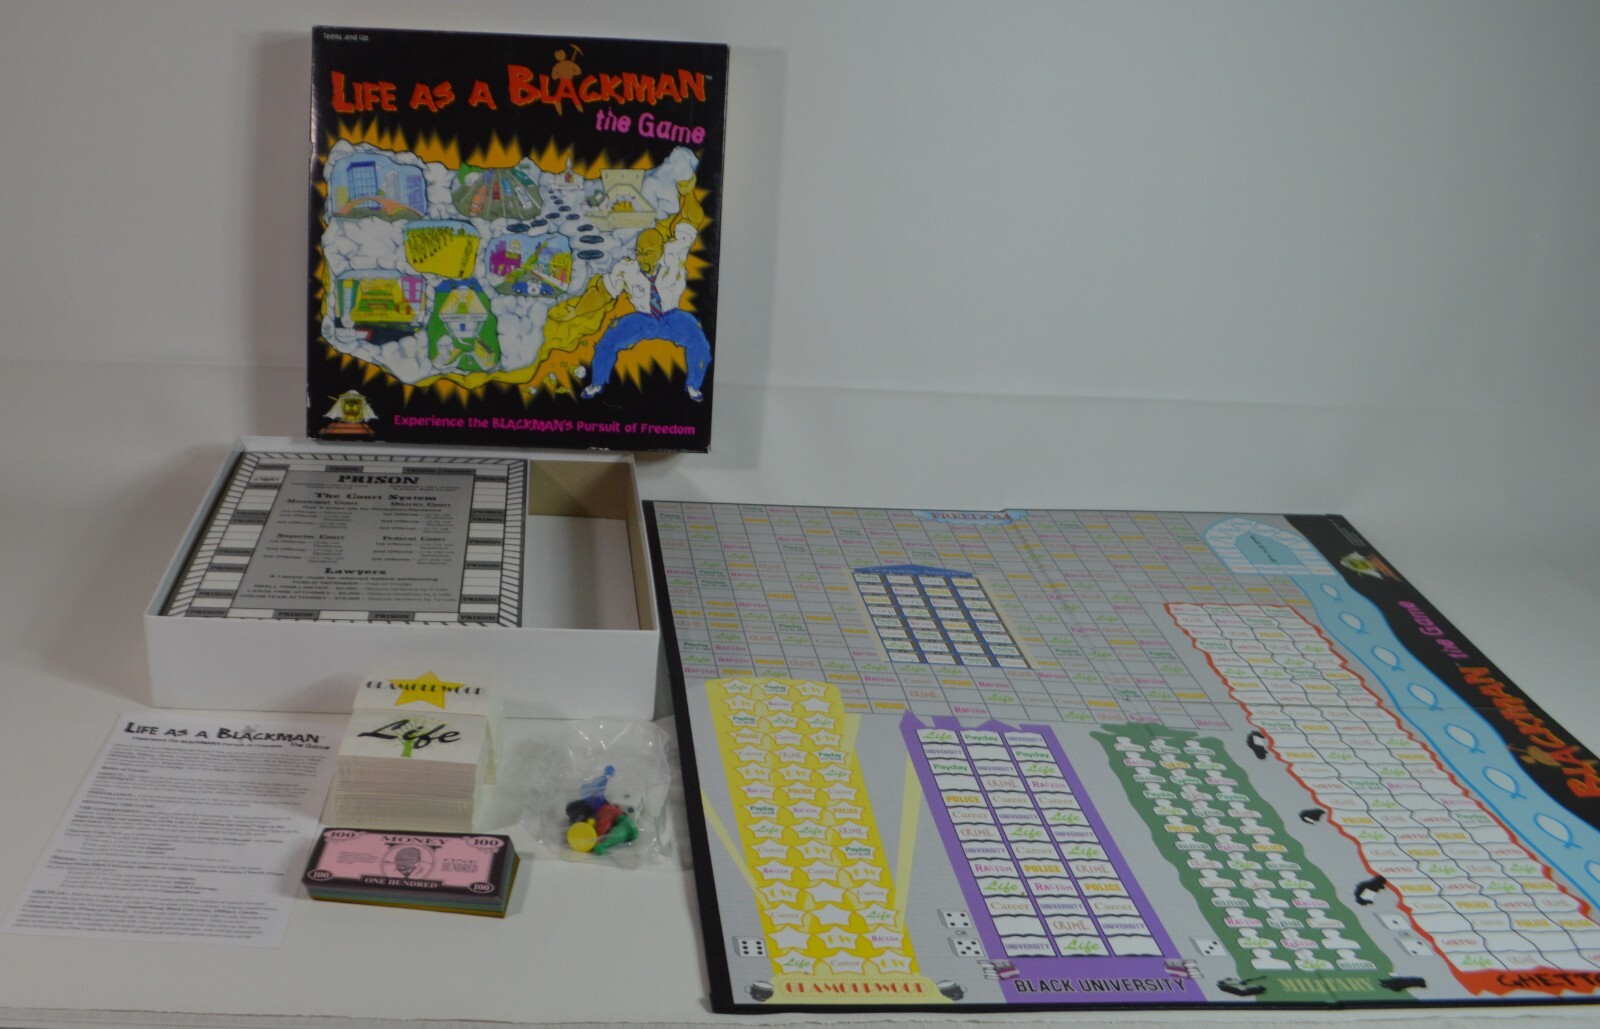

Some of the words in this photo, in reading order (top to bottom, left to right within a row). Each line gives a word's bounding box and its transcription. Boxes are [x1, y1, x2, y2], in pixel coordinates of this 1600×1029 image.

[331, 71, 397, 113] LIFE
[409, 81, 456, 112] AS
[468, 80, 498, 111] A
[507, 64, 706, 106] BLACKMAN
[595, 106, 631, 133] the
[638, 112, 706, 144] Game
[393, 415, 464, 428] Experience
[467, 417, 489, 429] the
[492, 417, 574, 432] BLACKMAN'S
[576, 421, 621, 433] Pursuit
[624, 423, 637, 433] of
[641, 424, 695, 436] Freedom
[338, 475, 420, 485] PRISON
[314, 492, 341, 500] The
[931, 512, 1011, 521] FREEDOM
[324, 567, 386, 577] Lawyers
[1398, 601, 1444, 636] Game
[1436, 638, 1470, 659] the
[124, 721, 159, 735] LIFE
[164, 727, 189, 737] AS
[195, 730, 208, 739] A
[216, 727, 320, 743] BLACKMAN
[357, 719, 461, 749] Life
[922, 731, 954, 741] Life
[965, 734, 998, 742] Payday
[1015, 750, 1050, 759] Payday
[933, 763, 969, 772] Payday
[1025, 764, 1056, 774] Life
[1050, 812, 1081, 823] Life
[758, 823, 780, 834] Life
[801, 824, 823, 834] Life
[1011, 828, 1042, 839] Life
[330, 831, 356, 839] 100
[381, 835, 448, 845] MONEY
[473, 838, 499, 848] 100
[1067, 845, 1099, 856] Life
[441, 862, 478, 873] HUNDRED
[1024, 864, 1061, 873] POLICE
[313, 871, 329, 879] 100
[364, 877, 386, 886] ONE
[388, 879, 438, 889] HUNDRED
[473, 883, 491, 892] 100
[983, 881, 1018, 892] Life
[1084, 882, 1122, 891] POLICE
[990, 901, 1030, 911] Career
[1094, 901, 1133, 911] Career
[866, 910, 891, 920] Life
[1053, 921, 1089, 931] CRIME
[1005, 942, 1050, 950] UNIVERSITY
[1063, 939, 1099, 953] Life
[783, 958, 810, 968] Life
[1015, 979, 1076, 992] BLACK
[1081, 979, 1186, 992] UNIVERSITY
